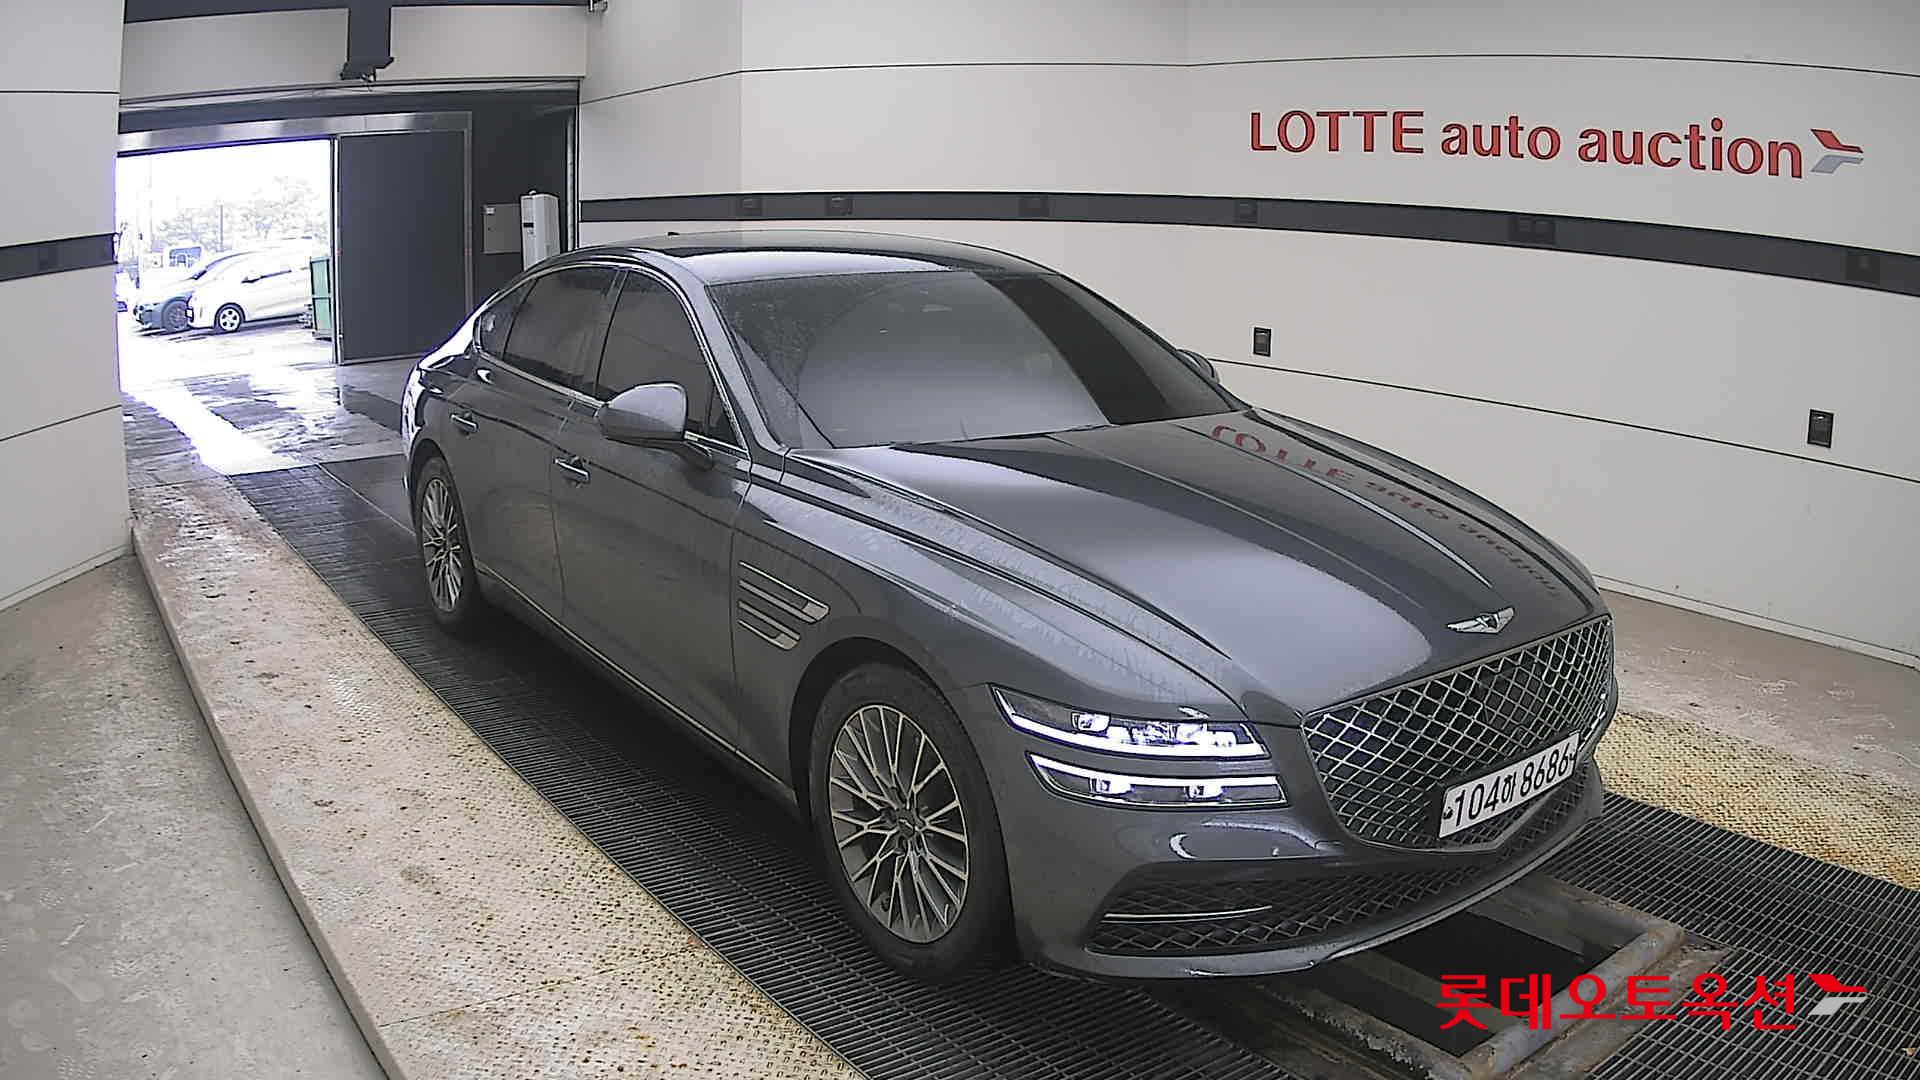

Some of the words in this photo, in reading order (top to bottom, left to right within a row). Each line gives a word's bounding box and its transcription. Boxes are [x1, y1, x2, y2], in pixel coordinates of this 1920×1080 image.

[1250, 110, 1424, 154] LOTTE
[1441, 115, 1561, 160] auto
[1577, 116, 1803, 179] auction
[1519, 742, 1570, 797] 8686
